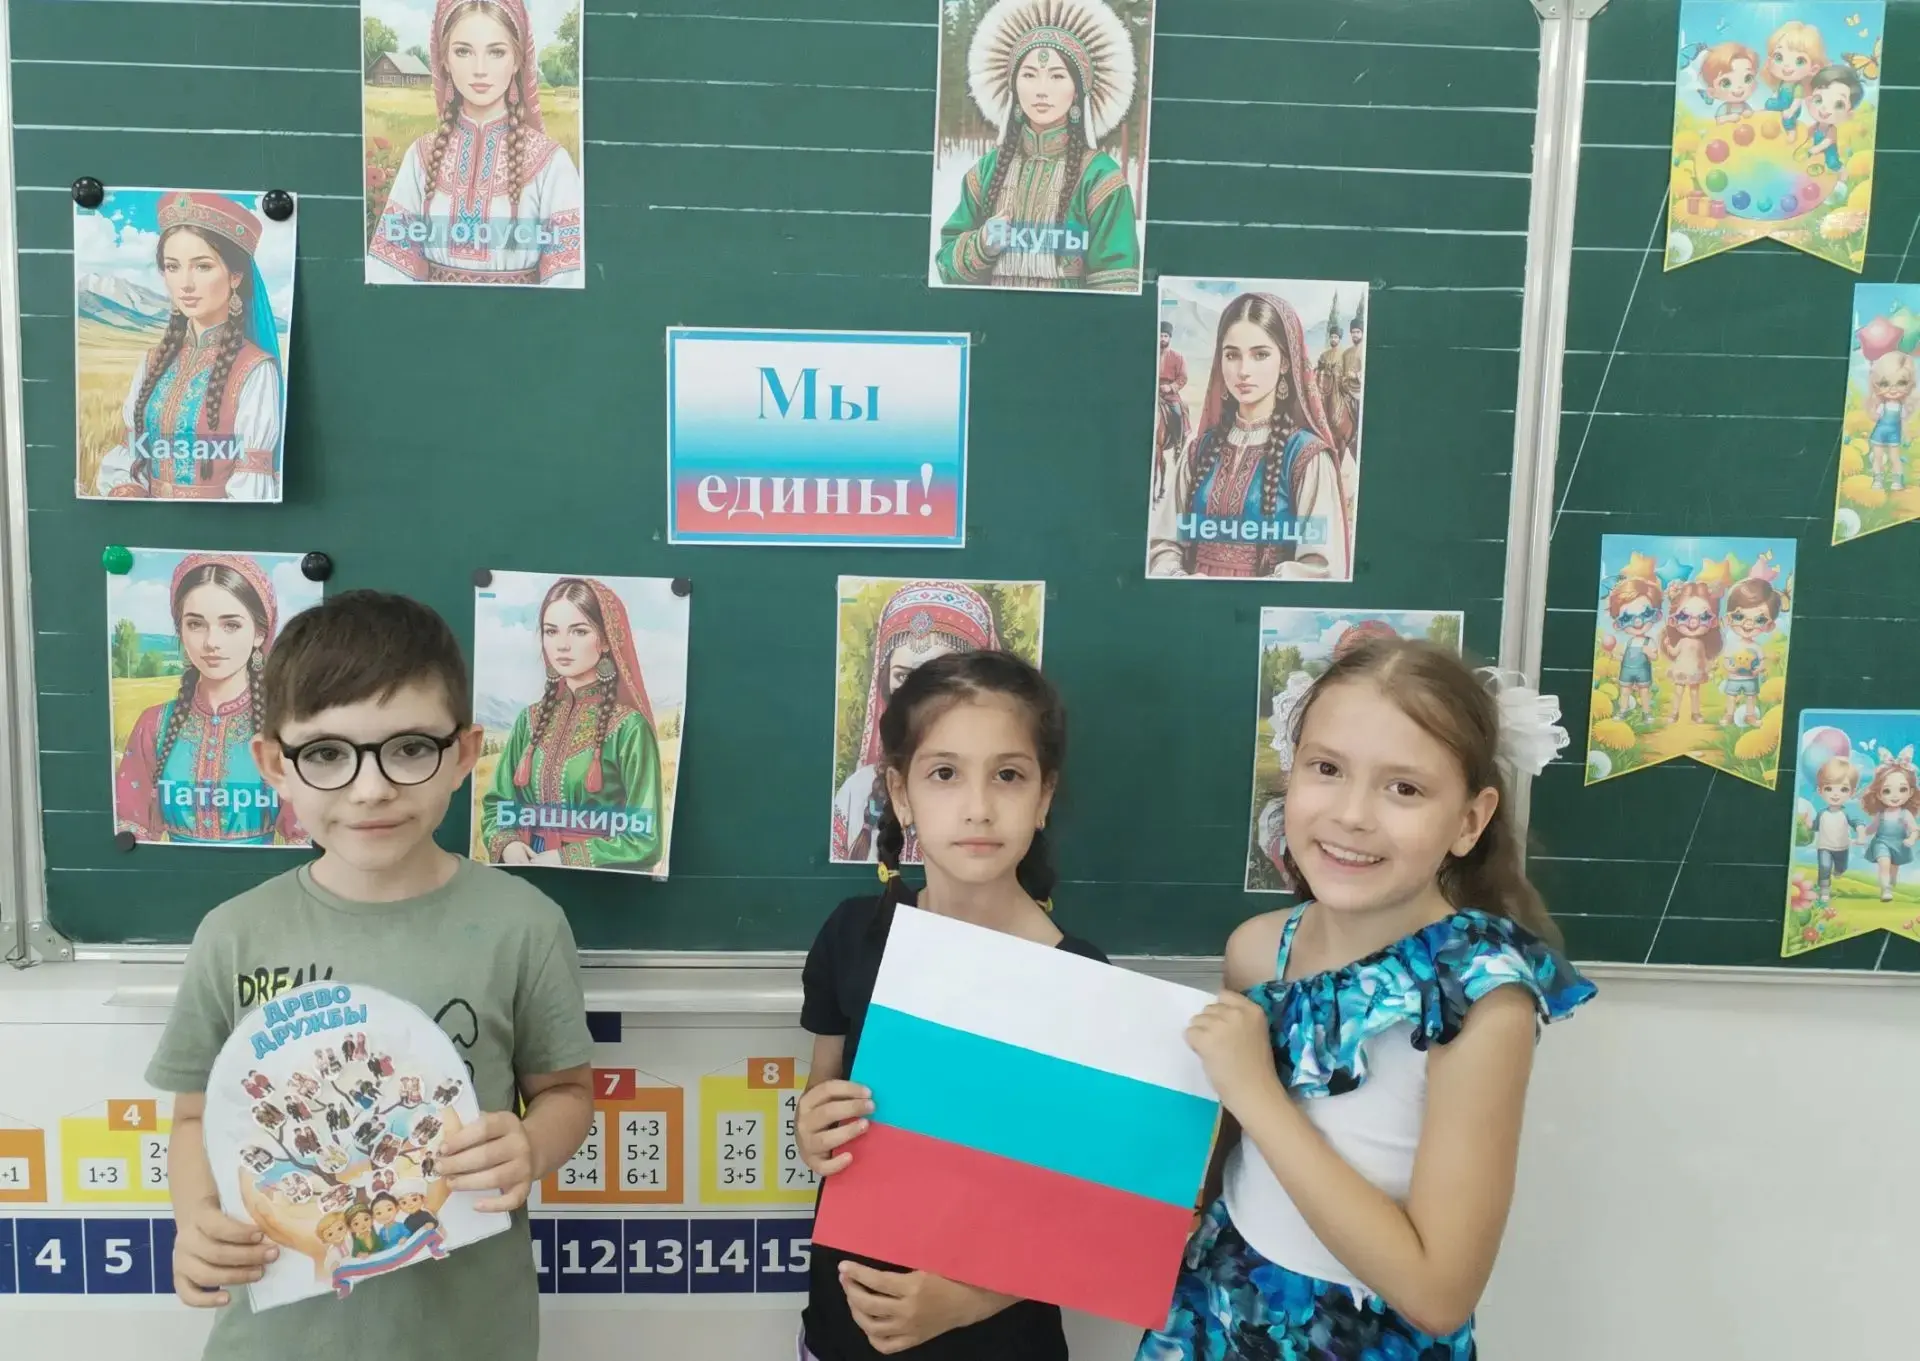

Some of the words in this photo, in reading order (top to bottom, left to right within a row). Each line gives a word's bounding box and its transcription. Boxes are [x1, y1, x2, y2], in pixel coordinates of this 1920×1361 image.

[384, 213, 560, 251] Белорусы
[986, 219, 1089, 254] Якуты
[756, 366, 881, 421] Мы
[128, 431, 245, 460] Казахи
[697, 462, 934, 520] едины!
[1176, 512, 1327, 545] Чеченцы
[158, 779, 279, 813] Татары
[496, 800, 653, 837] Башкиры
[263, 985, 351, 1028] ДРЕВО
[250, 1003, 367, 1060] ДРУЖБЫ
[603, 1073, 621, 1096] 7
[762, 1062, 780, 1085] 8
[122, 1104, 142, 1127] 4
[626, 1120, 660, 1137] 4+3
[725, 1119, 757, 1136] 1+7
[150, 1142, 168, 1159] 2+
[627, 1144, 660, 1161] 5+2
[723, 1143, 757, 1160] 2+6
[89, 1166, 118, 1183] 1+3
[565, 1168, 598, 1184] 3+4
[626, 1168, 660, 1184] 6+1
[723, 1167, 756, 1184] 3+5
[35, 1238, 67, 1274] 4
[105, 1238, 133, 1274] 5
[562, 1239, 617, 1274] 12
[629, 1239, 684, 1274] 13
[695, 1239, 749, 1273] 14
[761, 1238, 812, 1273] 15
